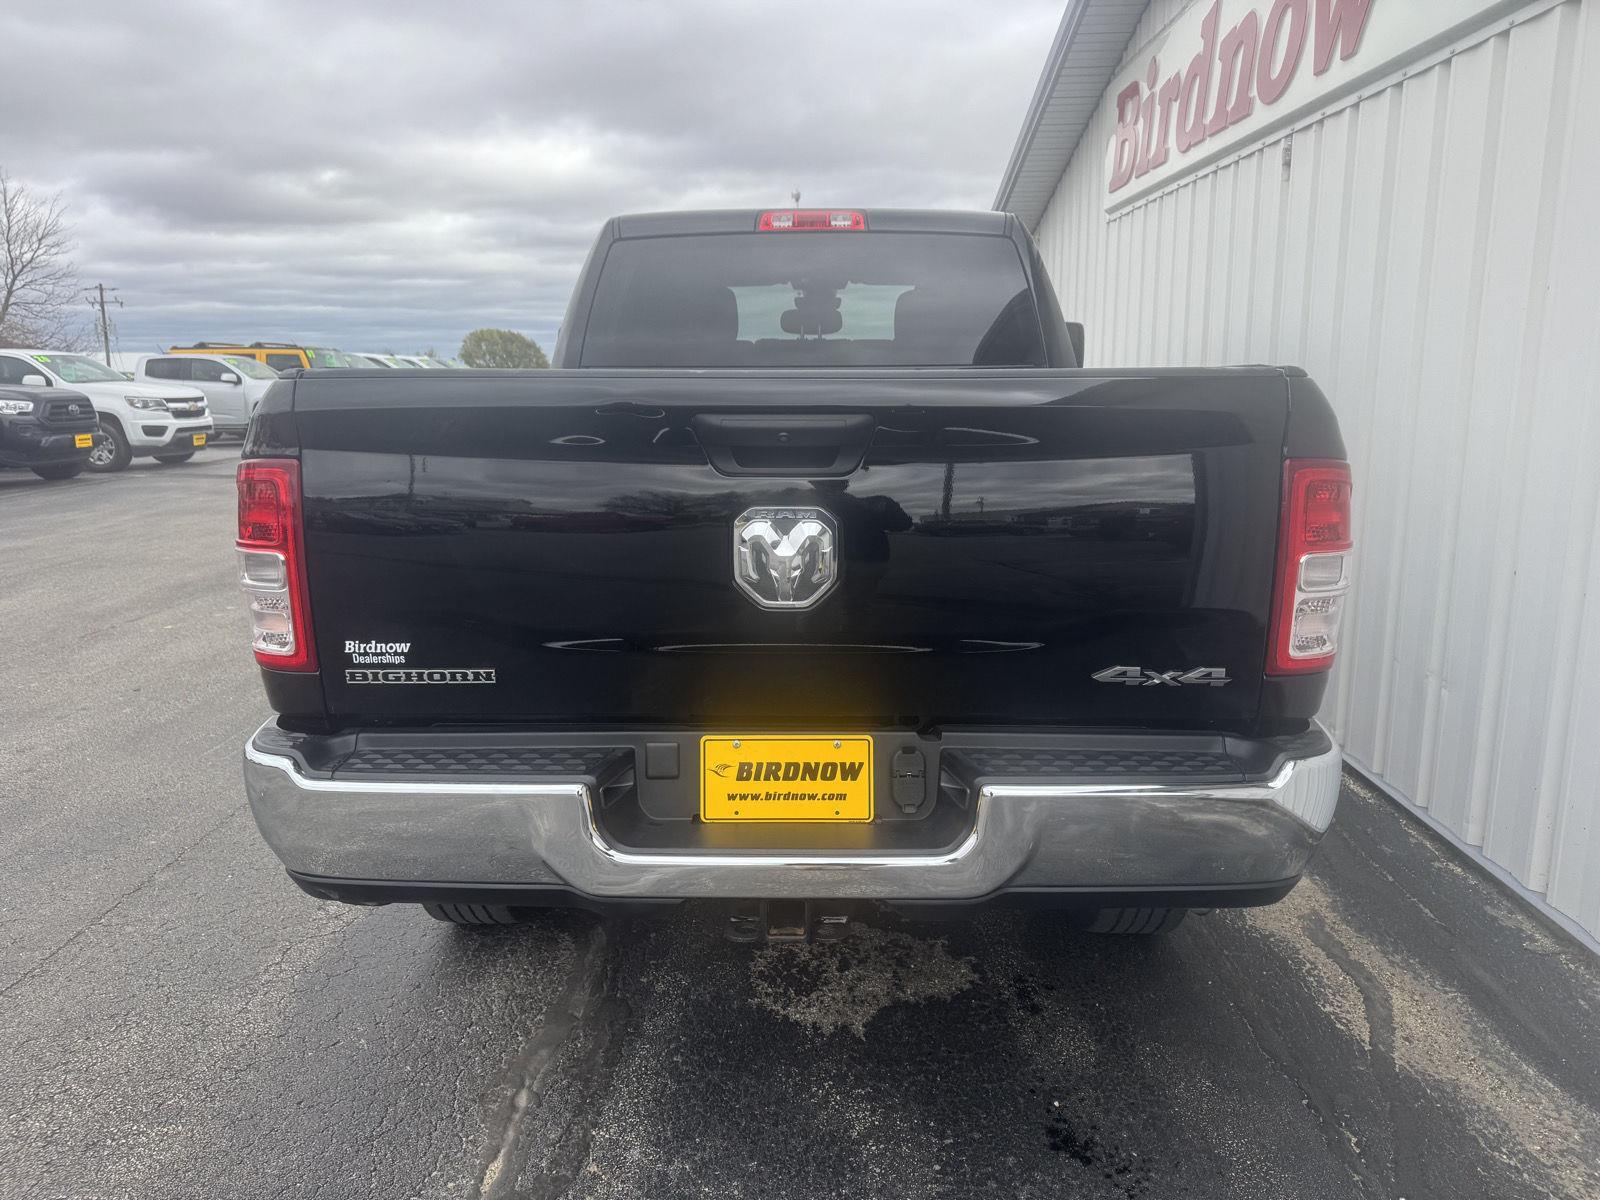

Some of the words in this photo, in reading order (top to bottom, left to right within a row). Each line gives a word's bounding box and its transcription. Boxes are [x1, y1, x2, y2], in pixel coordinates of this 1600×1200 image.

[755, 510, 817, 519] RAM
[344, 640, 411, 653] Birdnow
[352, 653, 406, 665] Dealerships
[345, 669, 496, 684] BIGHORN
[736, 761, 864, 782] BIRDNOW
[727, 791, 847, 801] www.birdnow.com
